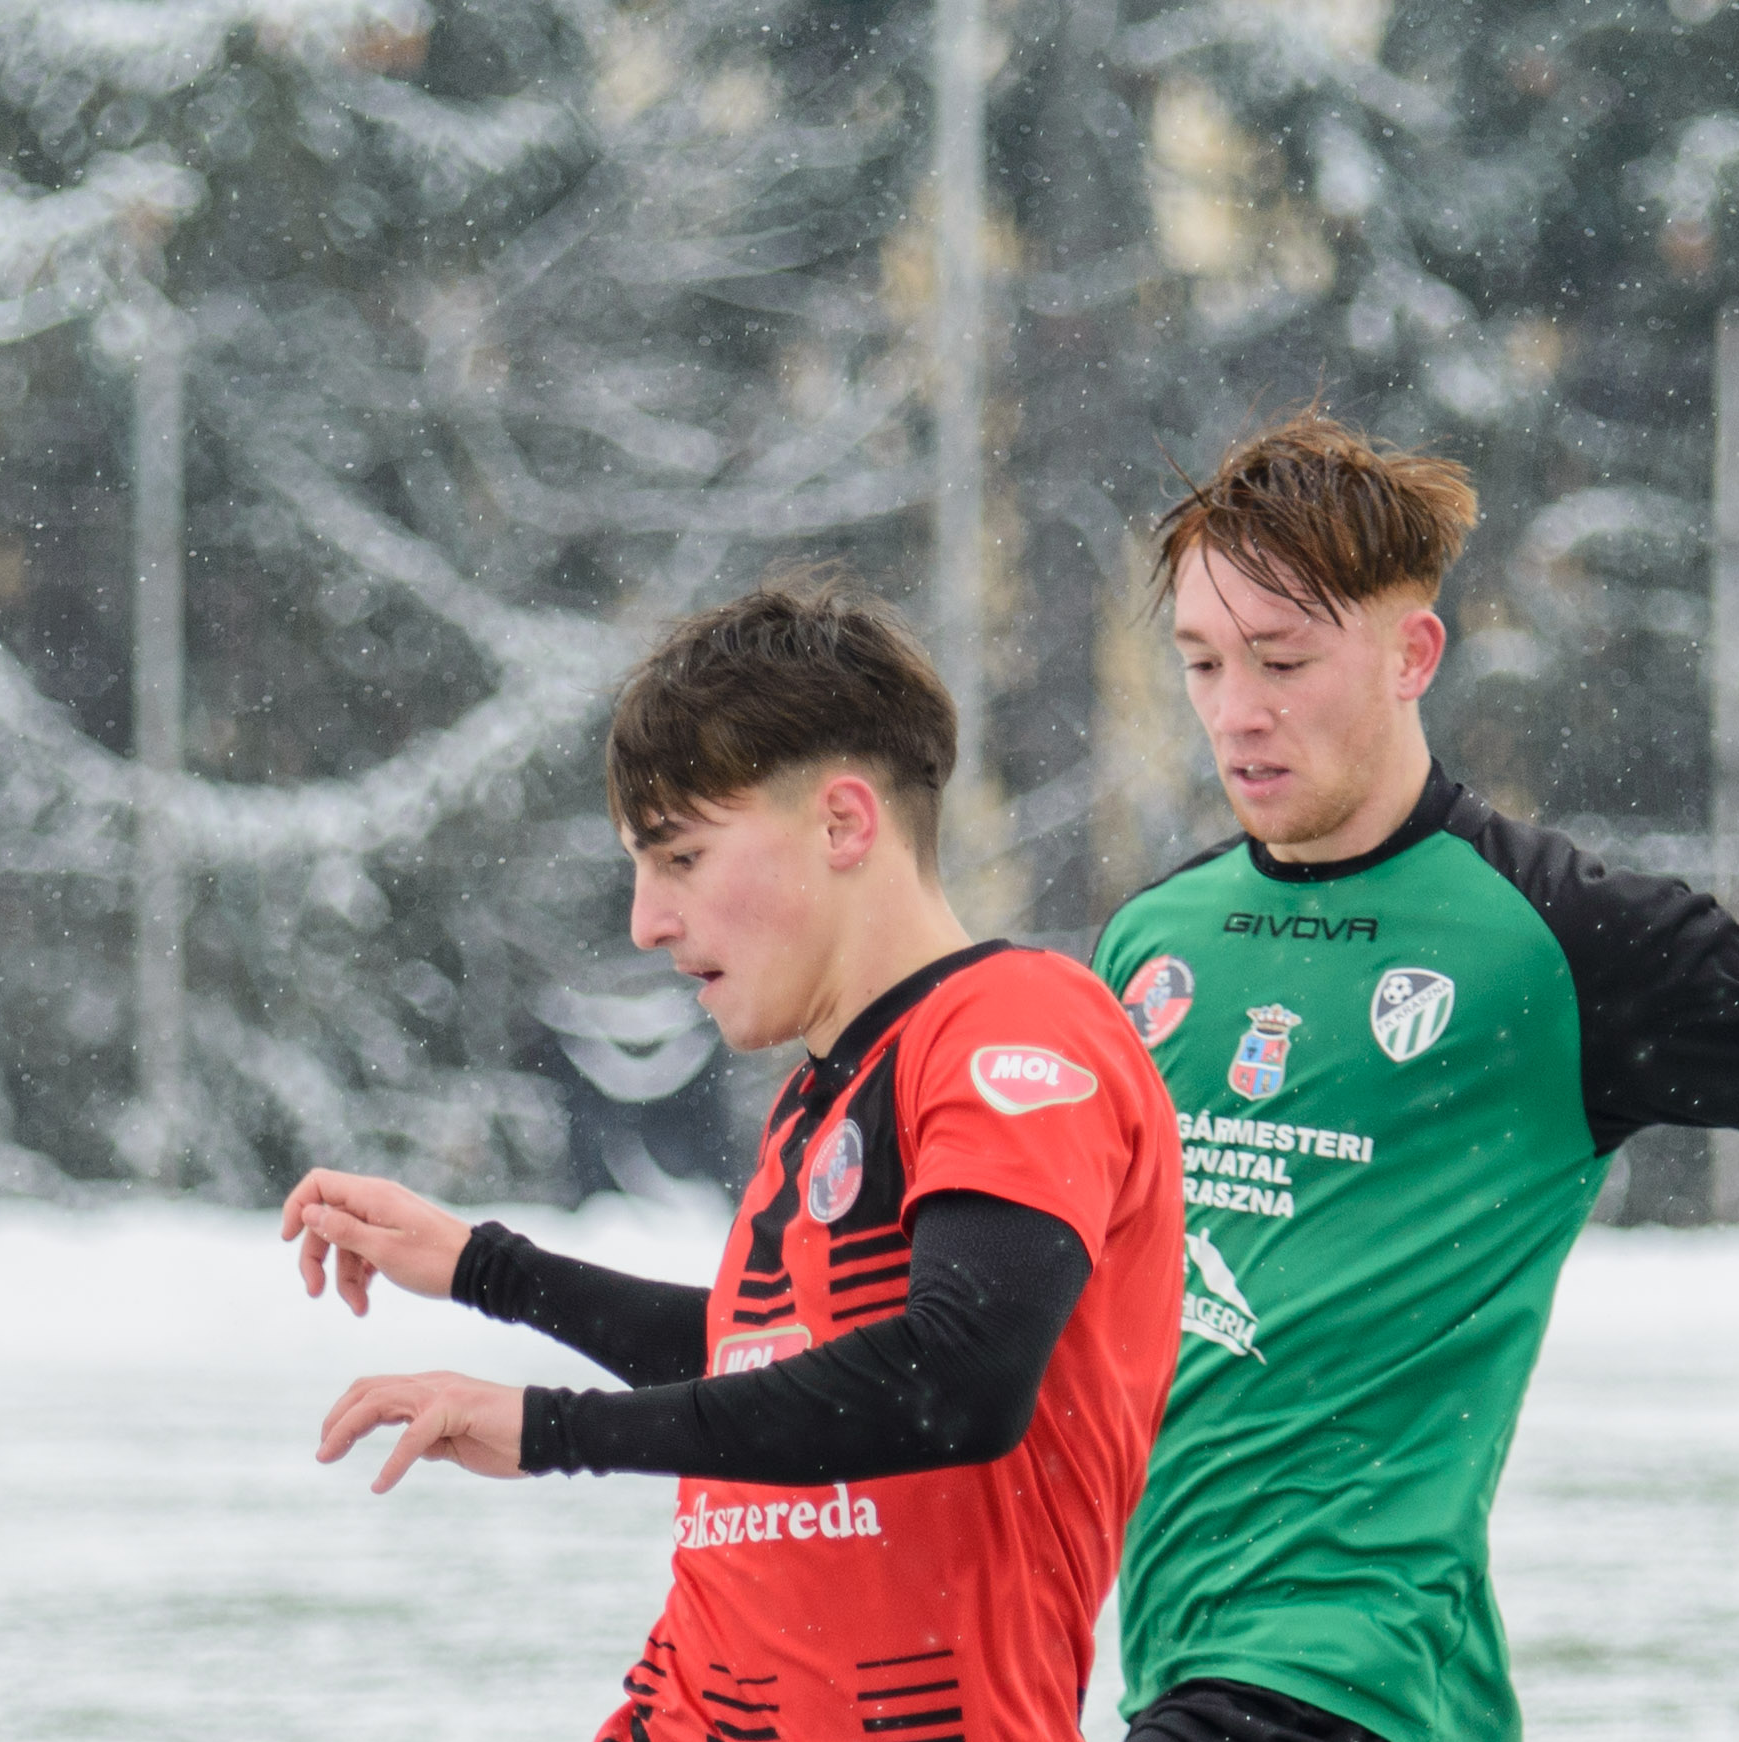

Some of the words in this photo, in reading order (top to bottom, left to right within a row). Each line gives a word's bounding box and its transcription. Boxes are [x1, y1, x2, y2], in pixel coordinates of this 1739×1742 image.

[1223, 912, 1378, 942] GIVOVA
[989, 1055, 1060, 1087] MOL
[1176, 1109, 1374, 1163] GÁRMESTERI
